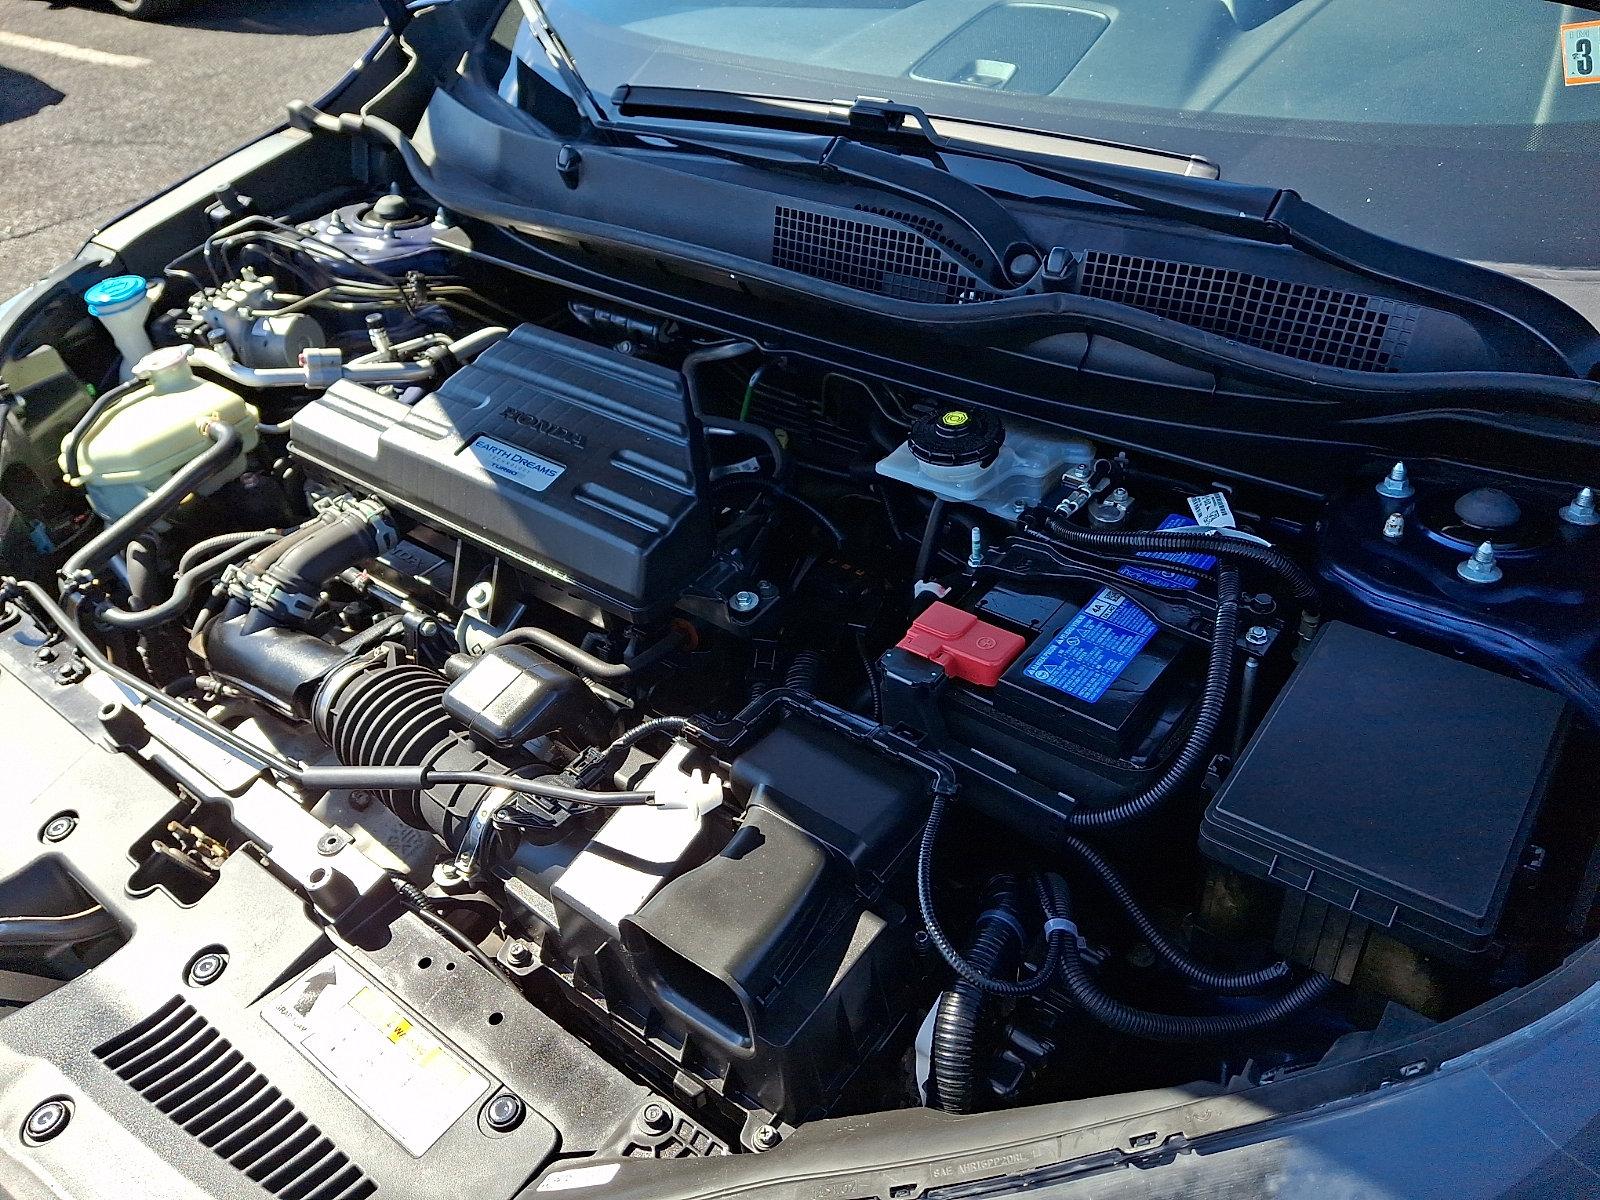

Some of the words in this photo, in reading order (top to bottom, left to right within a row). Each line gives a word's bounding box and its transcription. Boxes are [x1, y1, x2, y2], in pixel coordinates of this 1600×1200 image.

[1576, 38, 1593, 76] 3
[500, 406, 586, 450] HONDA
[475, 441, 510, 459] EARTH
[511, 453, 558, 477] DREAMS
[491, 462, 518, 476] TURBO
[1092, 603, 1104, 614] 4A
[932, 1165, 954, 1178] SAE
